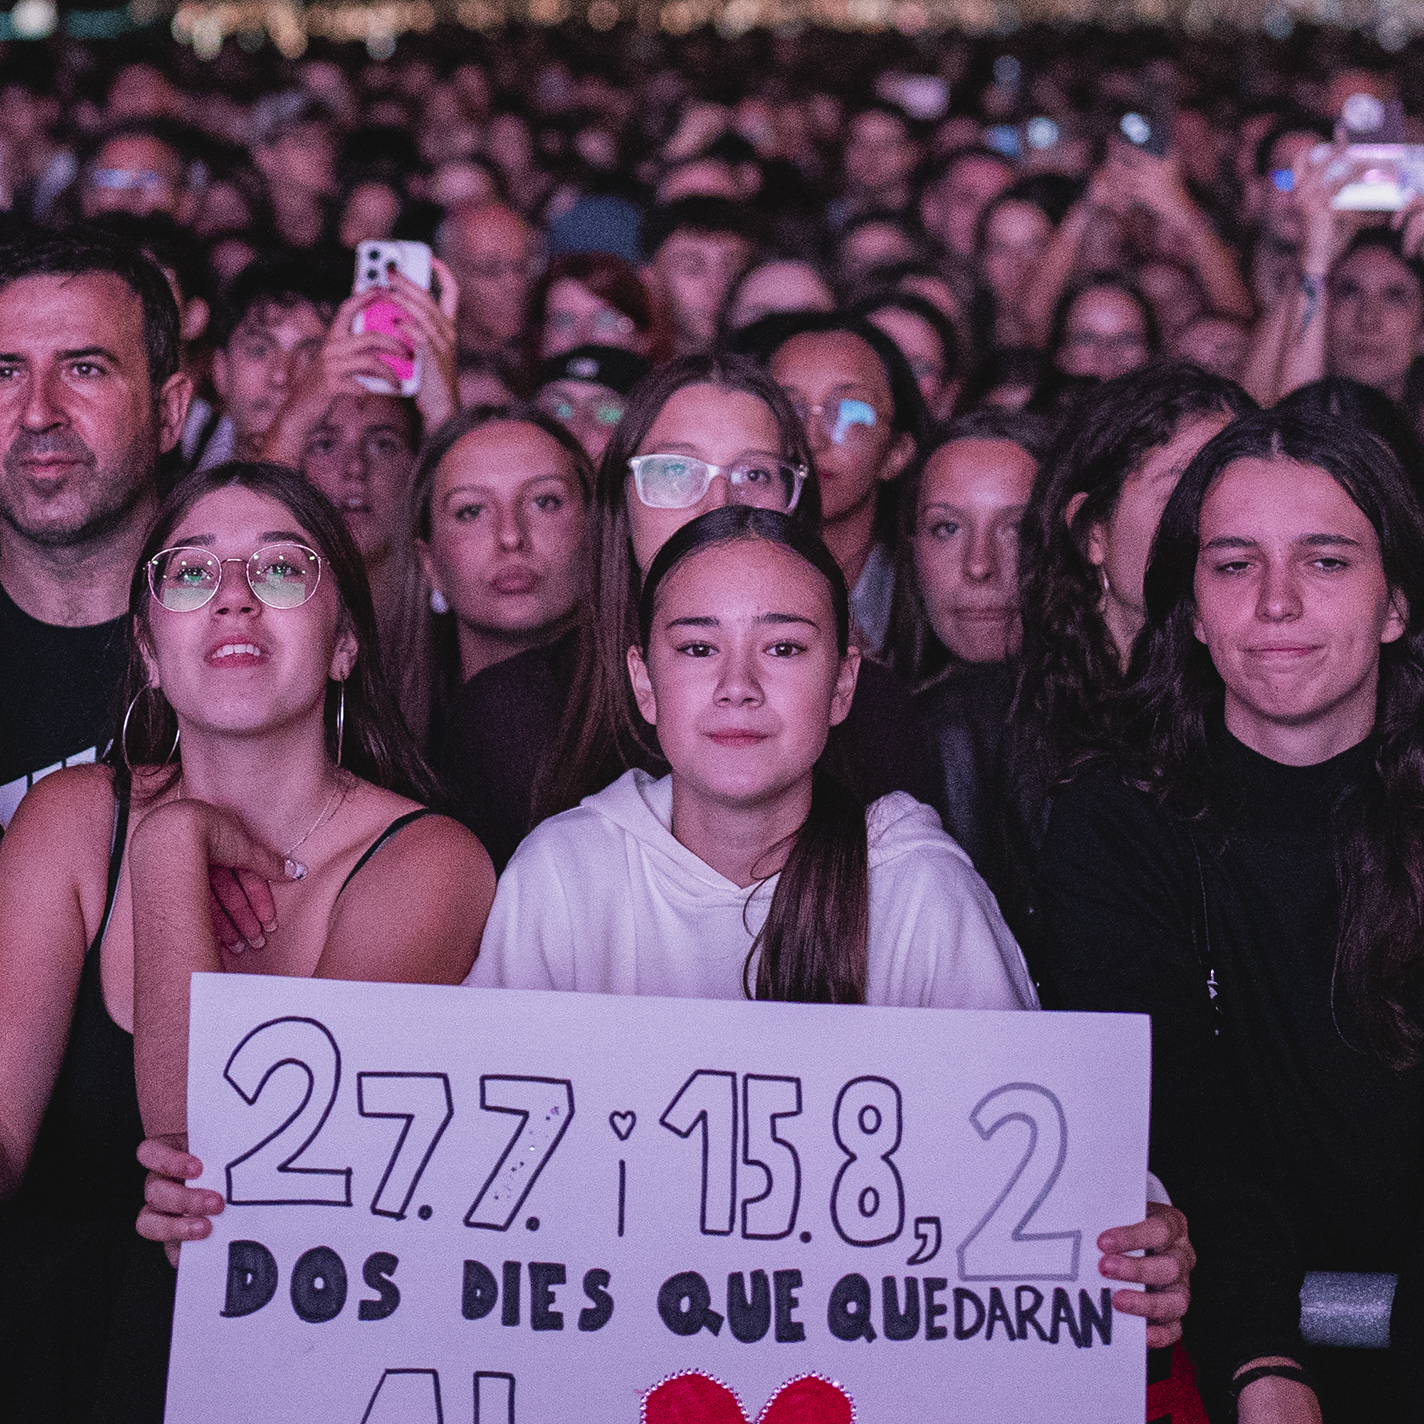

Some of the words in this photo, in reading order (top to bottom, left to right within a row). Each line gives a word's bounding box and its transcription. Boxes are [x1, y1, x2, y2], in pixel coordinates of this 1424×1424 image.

[608, 1110, 637, 1238] i
[219, 1239, 402, 1324] DOS
[461, 1259, 615, 1333] DIES
[657, 1268, 806, 1344] QUE
[827, 1272, 1113, 1349] QUEDARAN
